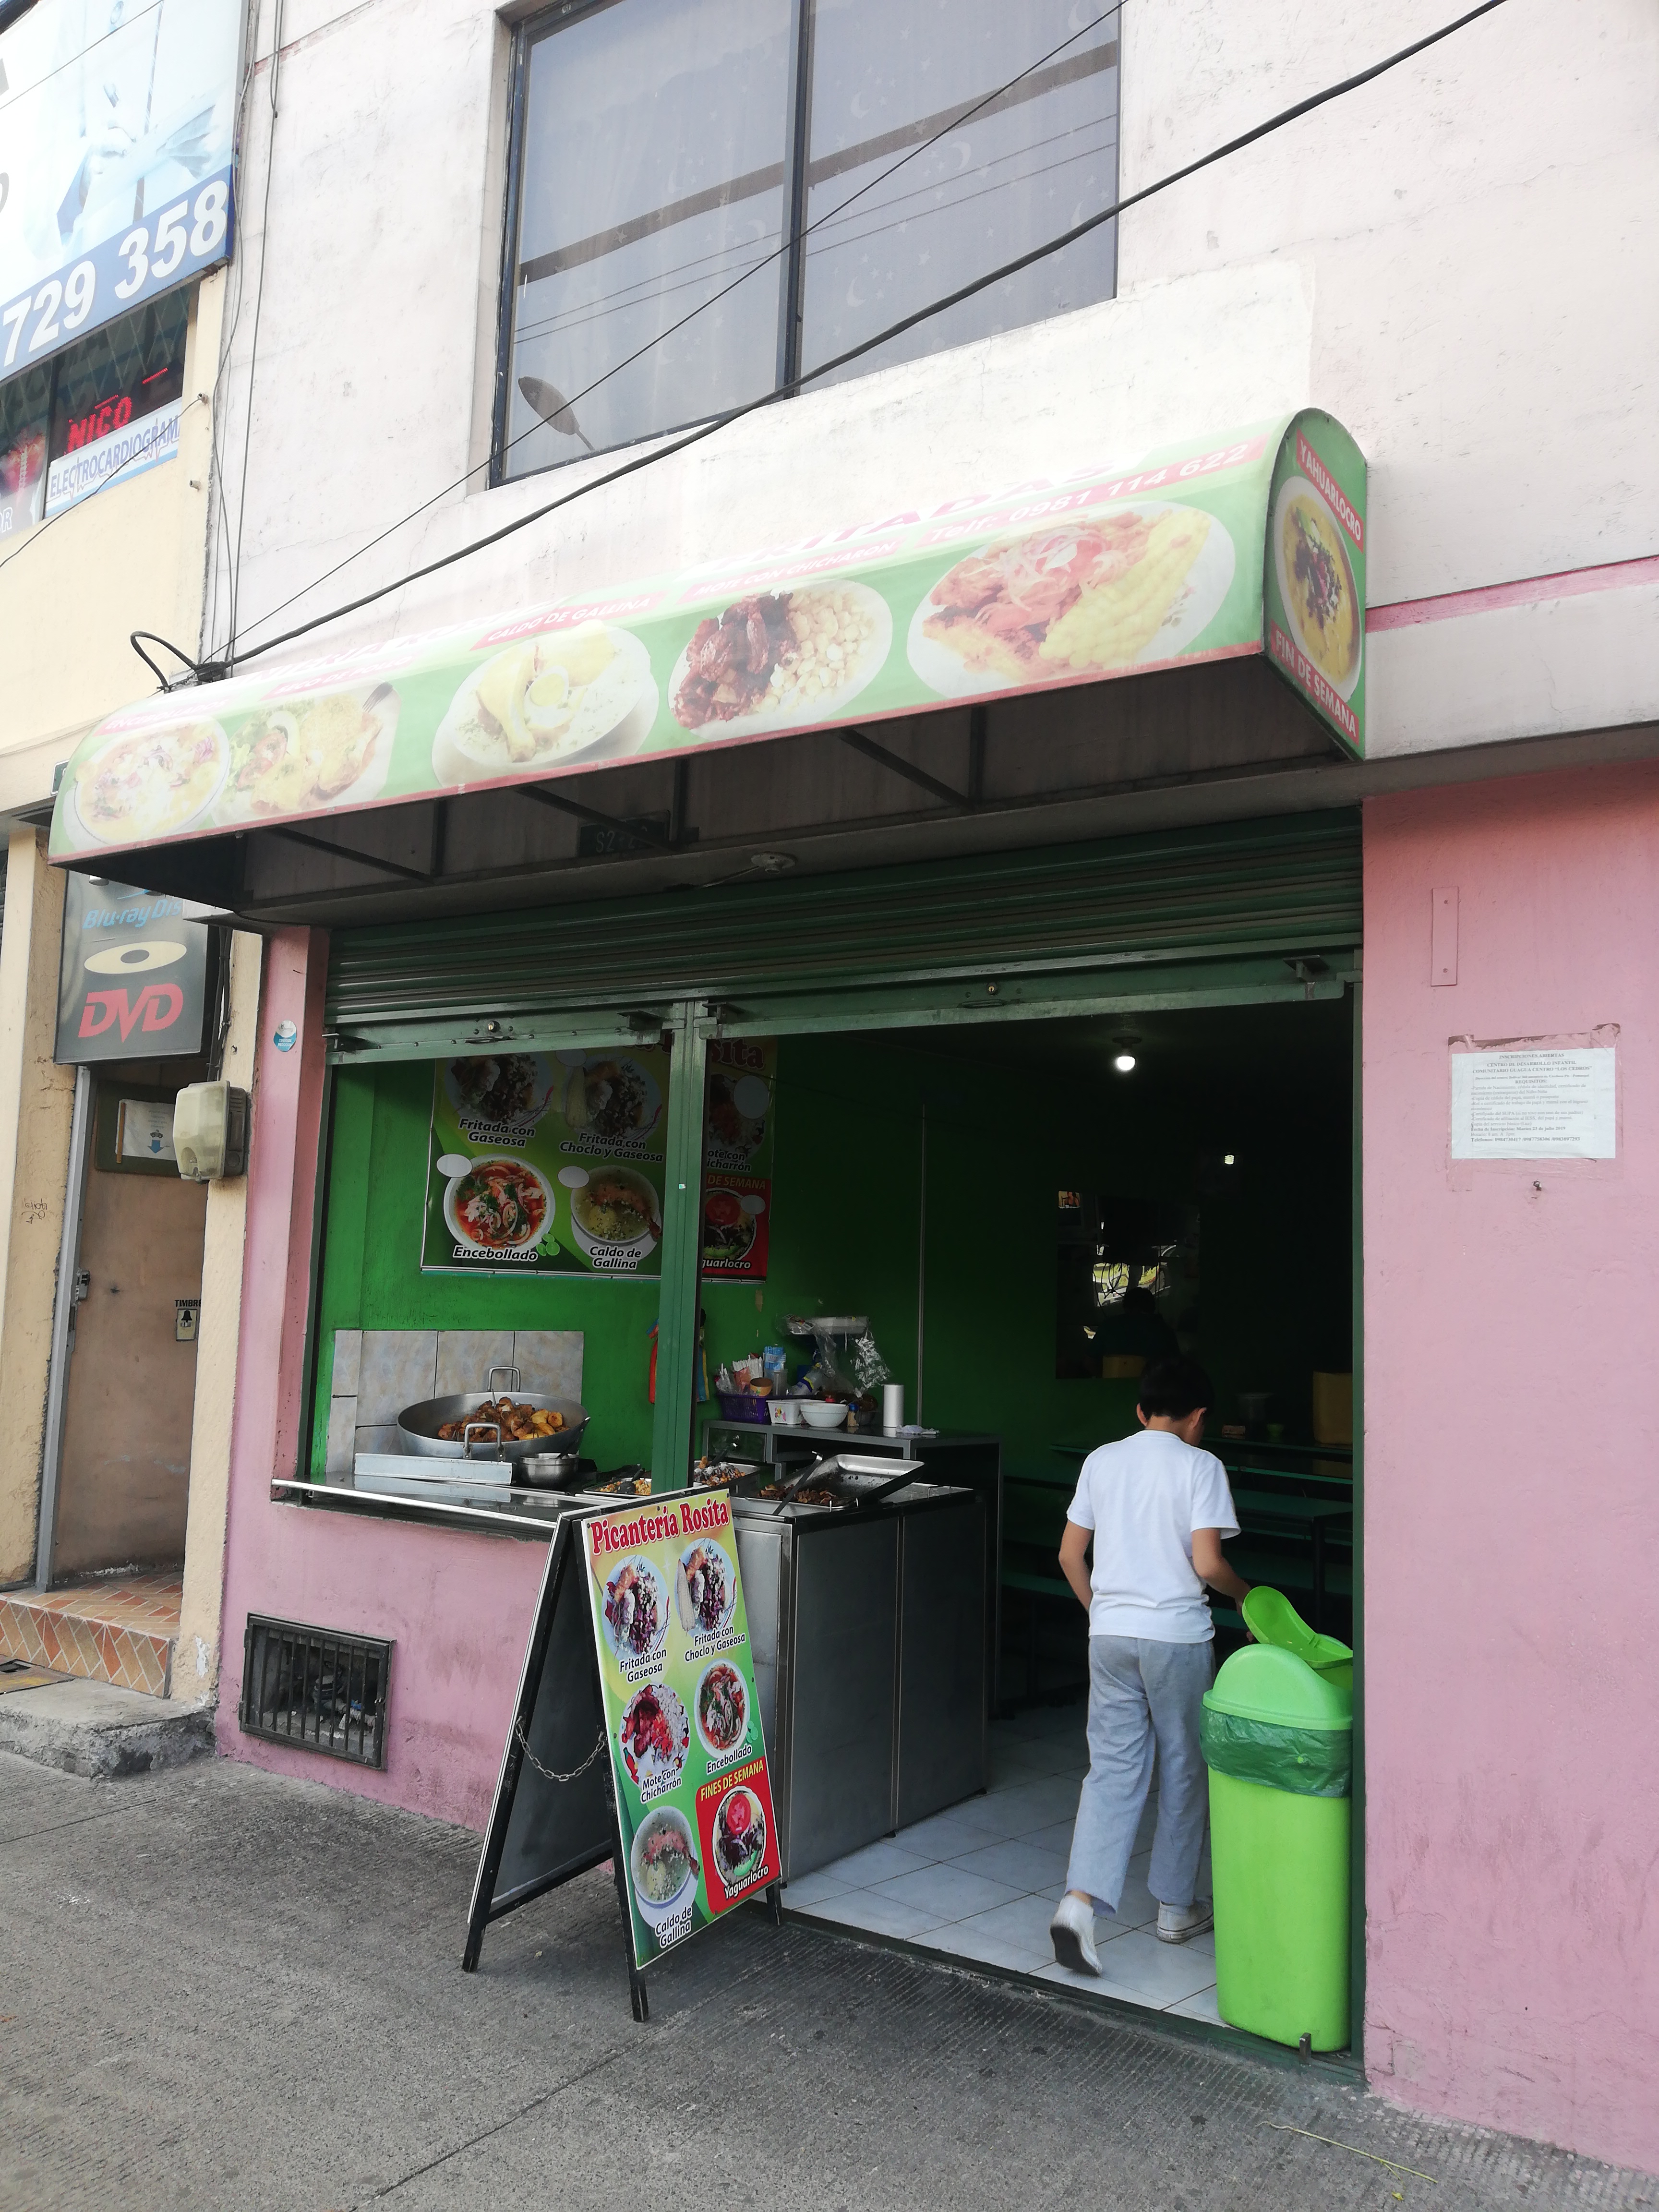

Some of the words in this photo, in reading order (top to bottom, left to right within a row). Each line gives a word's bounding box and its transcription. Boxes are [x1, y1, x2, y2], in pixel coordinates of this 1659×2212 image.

[3, 260, 95, 367] 729
[115, 180, 228, 299] 358
[50, 415, 180, 498] ELECTROCARDIOGRAM
[929, 515, 996, 542] Telf:
[1009, 491, 1092, 521] 0981
[1107, 472, 1166, 496] 114
[1179, 444, 1248, 476] 622
[1299, 438, 1362, 541] YAHUARLOCRO
[694, 577, 744, 597] MOTE
[744, 568, 784, 584] CON
[787, 541, 896, 575] CHICHARON
[488, 616, 543, 641] CALDO
[544, 610, 570, 624] DE
[571, 597, 650, 620] GALLINA
[272, 677, 319, 695] SECO
[322, 673, 344, 684] DE
[348, 656, 412, 678] POLLO
[1276, 631, 1295, 669] FIN
[1298, 659, 1311, 688] DE
[1314, 673, 1357, 738] SEMANA
[82, 904, 149, 928] Blu-ray
[152, 898, 183, 919] Dis
[78, 983, 183, 1043] DVD
[711, 1038, 764, 1069] sita
[459, 1118, 509, 1134] Fritada
[510, 1126, 535, 1136] con
[469, 1131, 526, 1147] Gaseosa
[560, 1142, 601, 1155] Choclo
[603, 1148, 611, 1158] y
[614, 1149, 663, 1162] Gaseosa
[579, 1133, 623, 1147] Fritada
[625, 1140, 646, 1149] con
[708, 1149, 725, 1159] ote
[727, 1151, 745, 1160] con
[707, 1157, 751, 1171] icharrón
[708, 1175, 721, 1185] DE
[723, 1177, 766, 1190] SEMANA
[454, 1246, 537, 1261] Encebollado
[590, 1246, 624, 1257] Caldo
[626, 1248, 641, 1258] de
[593, 1258, 637, 1269] Gallina
[702, 1258, 751, 1269] guarlocro
[590, 1505, 678, 1556] Picanteria
[680, 1498, 729, 1534] Rosita
[685, 1645, 710, 1662] Choclo
[711, 1645, 716, 1656] y
[717, 1633, 745, 1651] Gaseosa
[694, 1630, 720, 1646] Fritada
[721, 1625, 733, 1637] con
[620, 1654, 650, 1672] Fritada
[651, 1648, 666, 1661] con
[627, 1662, 663, 1683] Gaseosa
[707, 1744, 752, 1774] Encebollado
[641, 1777, 681, 1803] Chicharrón
[643, 1774, 661, 1789] Mote
[662, 1768, 676, 1781] con
[701, 1780, 721, 1801] FINES
[723, 1775, 733, 1789] DE
[734, 1762, 764, 1785] SEMANA
[725, 1864, 769, 1899] Yaguarlocro
[656, 1914, 680, 1936] Caldo
[681, 1906, 692, 1920] de
[660, 1924, 690, 1946] Gallina
